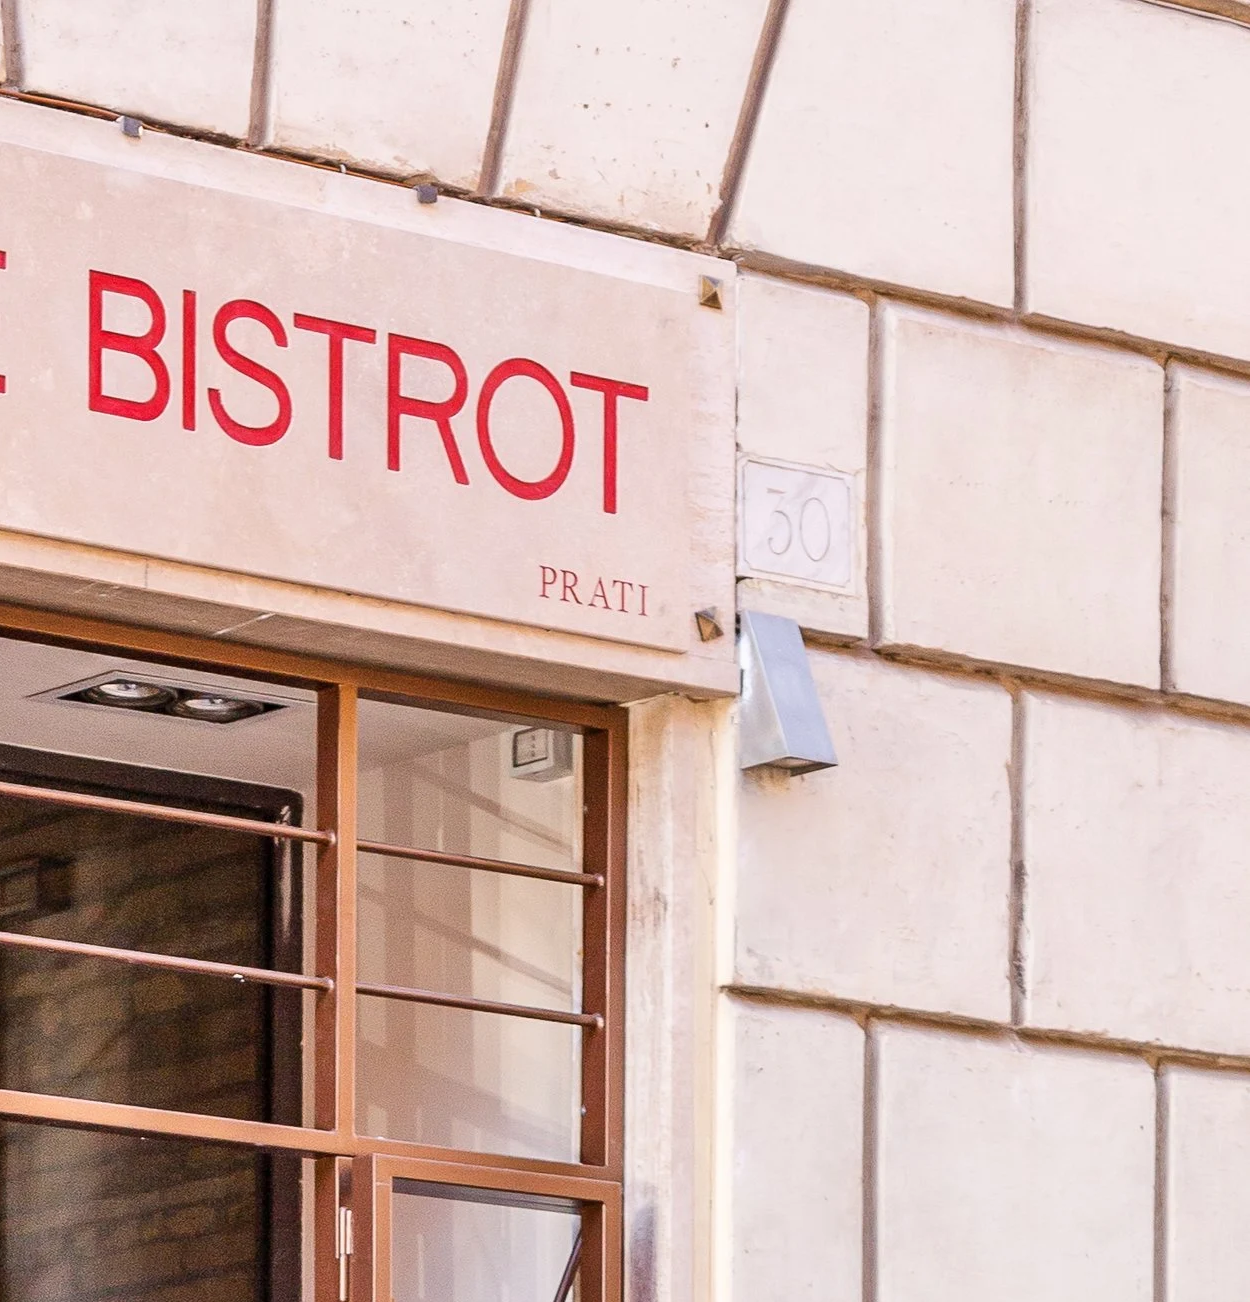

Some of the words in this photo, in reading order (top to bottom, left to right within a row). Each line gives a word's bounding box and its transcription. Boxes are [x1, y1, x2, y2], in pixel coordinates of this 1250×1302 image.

[88, 270, 650, 515] BISTROT
[766, 487, 831, 562] 30
[539, 565, 650, 617] PRATI
